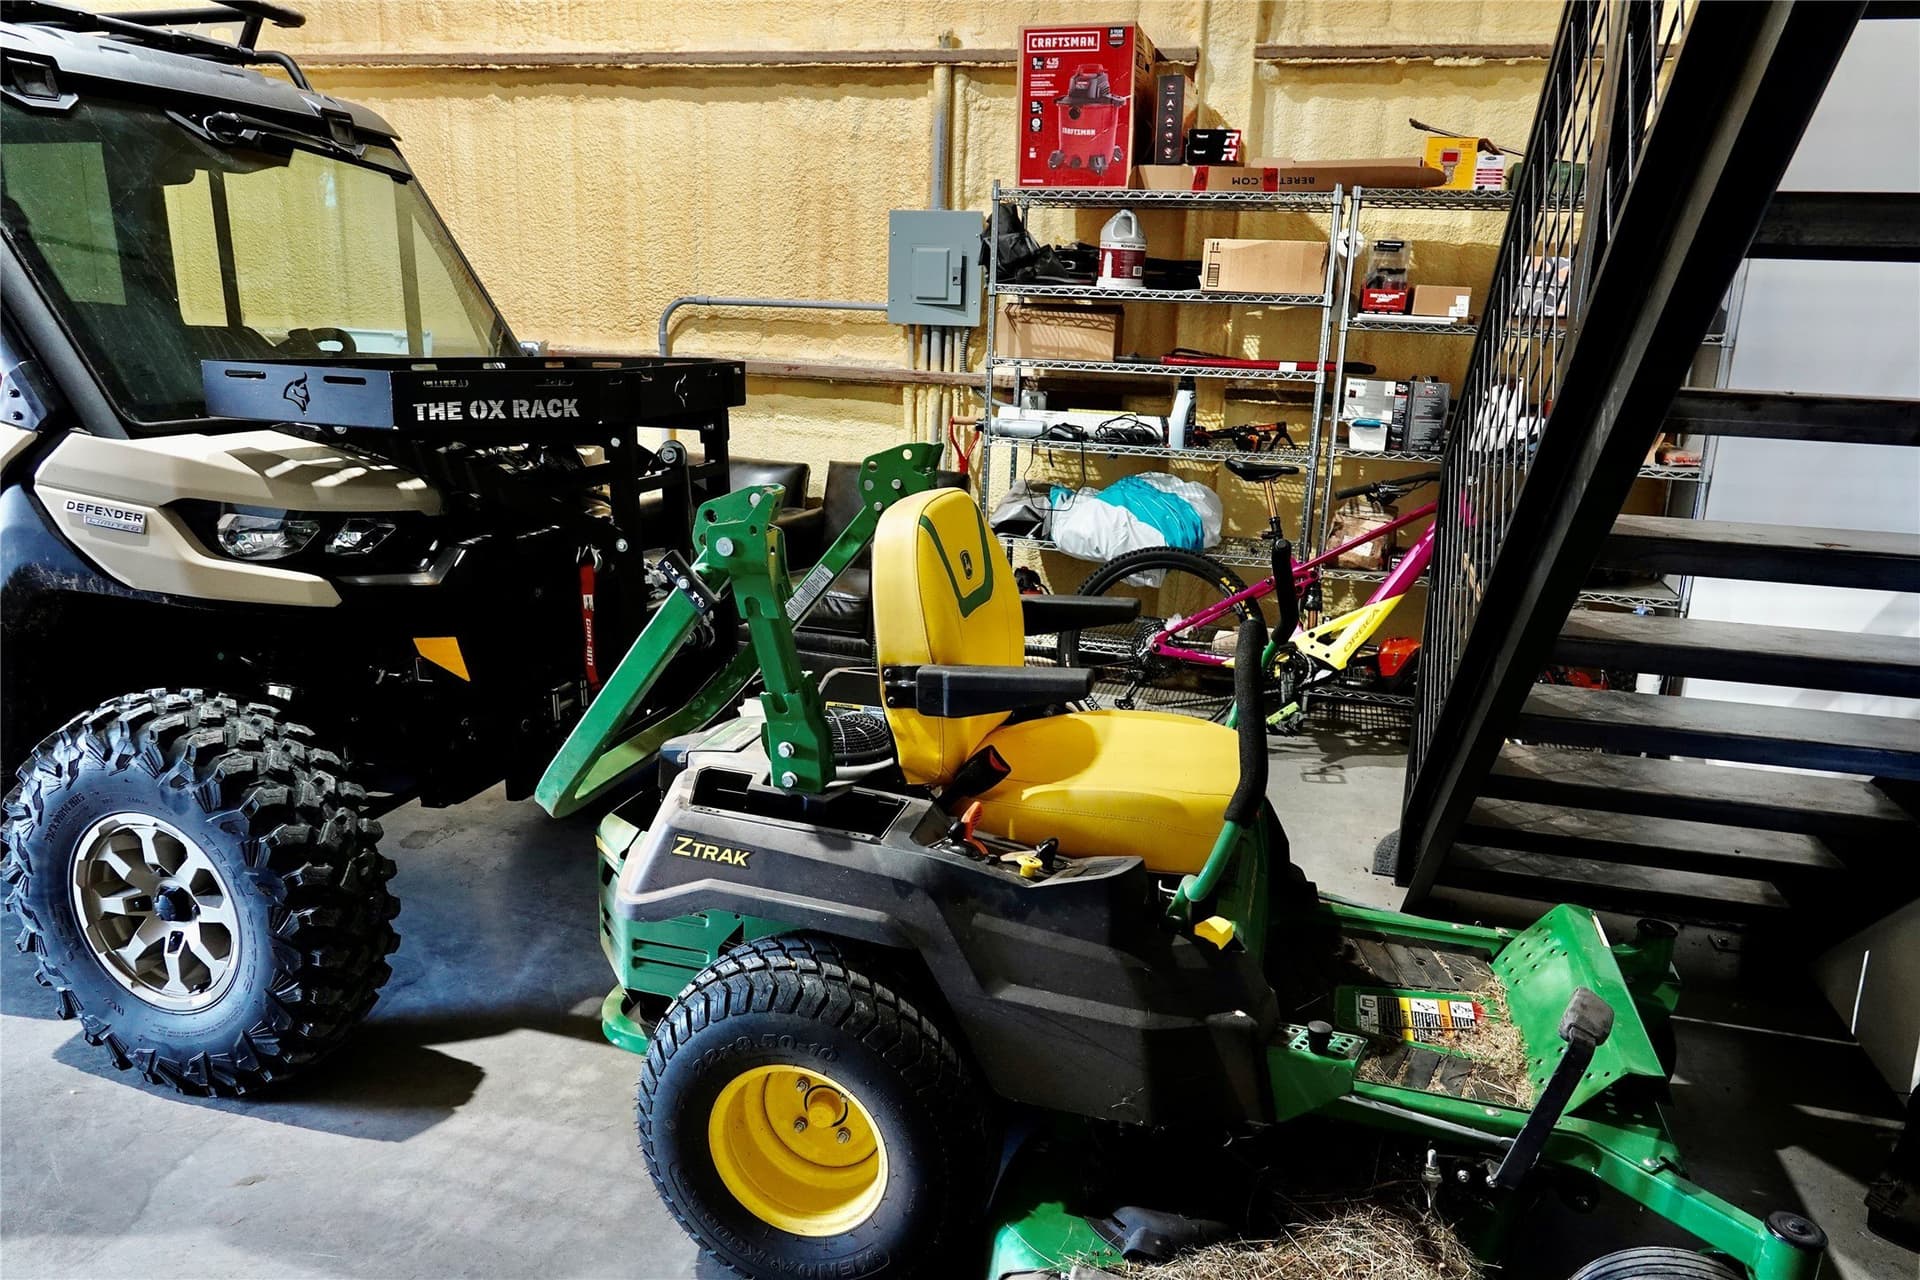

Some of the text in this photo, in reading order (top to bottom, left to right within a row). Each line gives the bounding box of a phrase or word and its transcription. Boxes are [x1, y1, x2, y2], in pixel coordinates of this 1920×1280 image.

[1031, 36, 1097, 48] CRAFTSMAN
[412, 398, 580, 422] THE OX RACK
[66, 500, 144, 523] DEFENDER
[1343, 609, 1381, 653] ORBEA
[672, 836, 750, 866] ZTRAK
